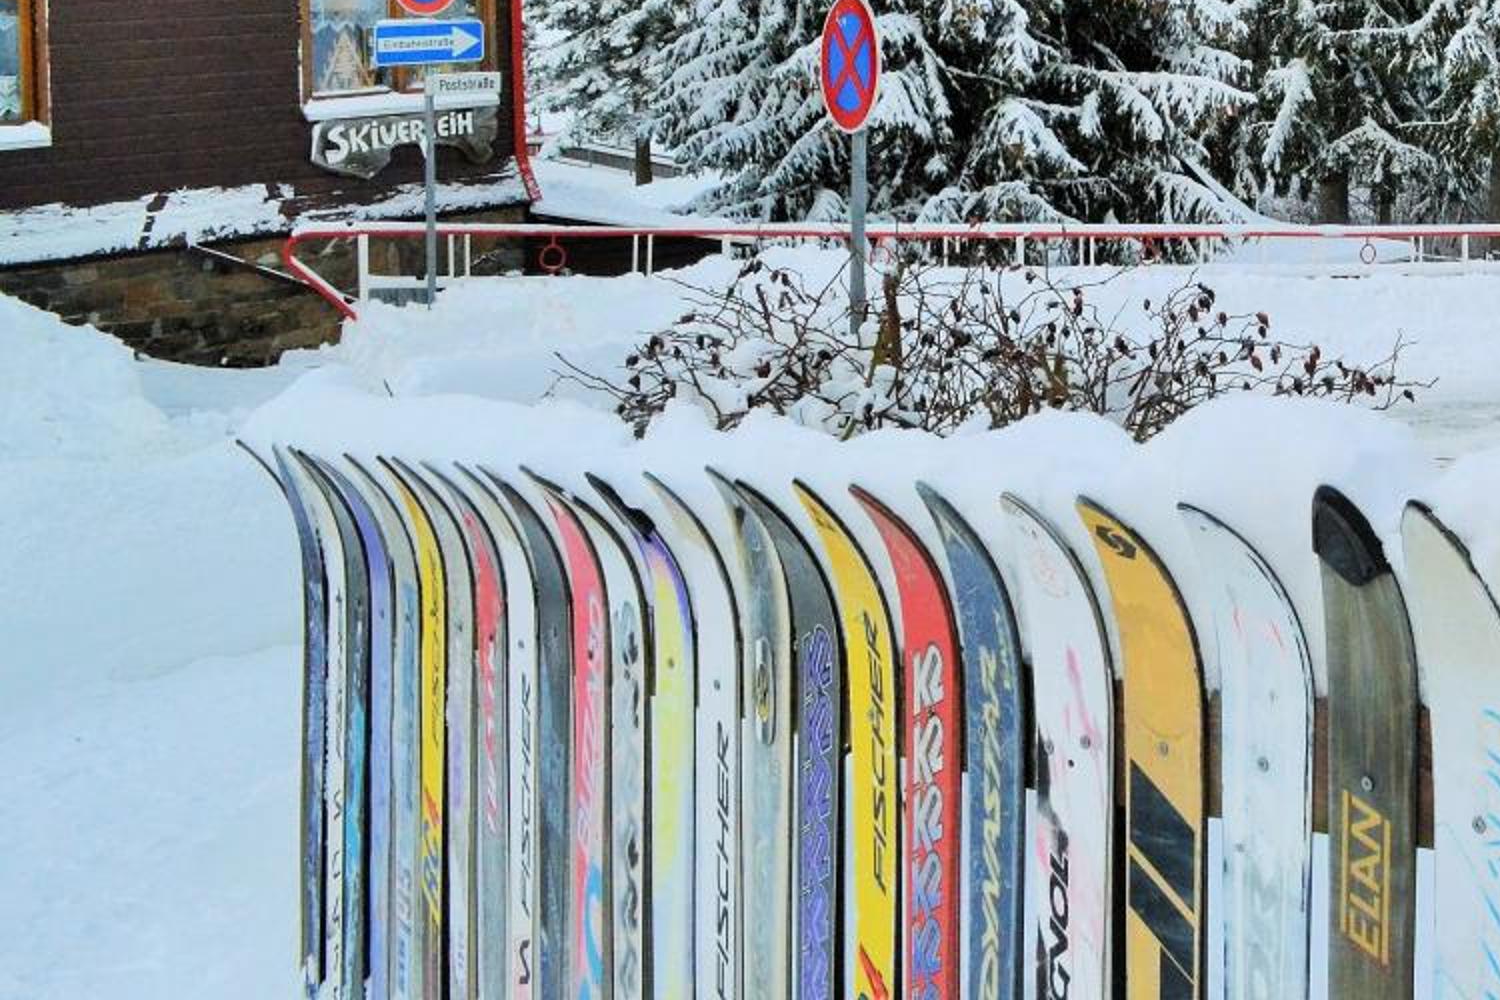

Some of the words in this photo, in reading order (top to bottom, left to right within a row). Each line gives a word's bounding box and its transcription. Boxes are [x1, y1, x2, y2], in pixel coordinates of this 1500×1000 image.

[439, 77, 494, 91] Poststraße
[520, 671, 532, 919] FISCHER
[715, 720, 730, 1000] FISCHER
[862, 610, 888, 896] FISCHER
[1349, 793, 1383, 958] ELAN
